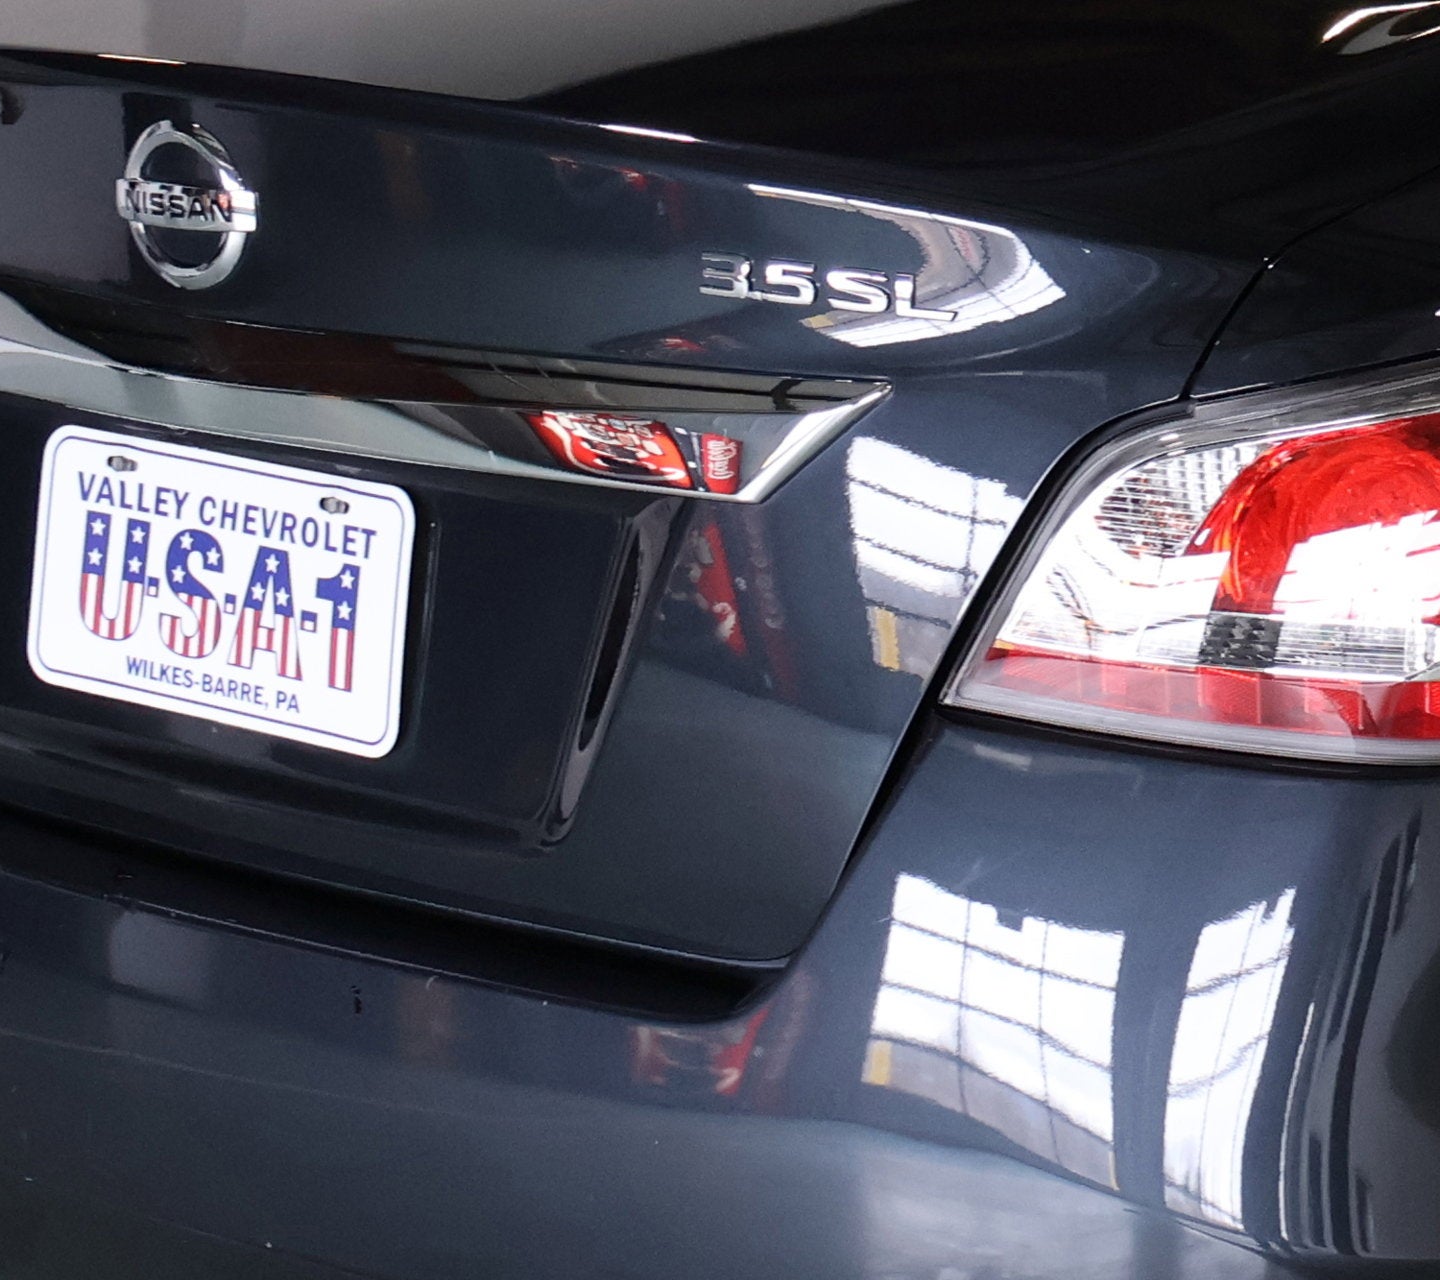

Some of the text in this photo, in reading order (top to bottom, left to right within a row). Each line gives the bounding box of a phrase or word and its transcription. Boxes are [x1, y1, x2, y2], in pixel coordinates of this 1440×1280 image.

[125, 188, 233, 223] NISSAN
[826, 266, 958, 321] SL
[78, 471, 377, 559] VALLEY CHEVROLET
[126, 655, 300, 713] WILKES-BARRE, PA
